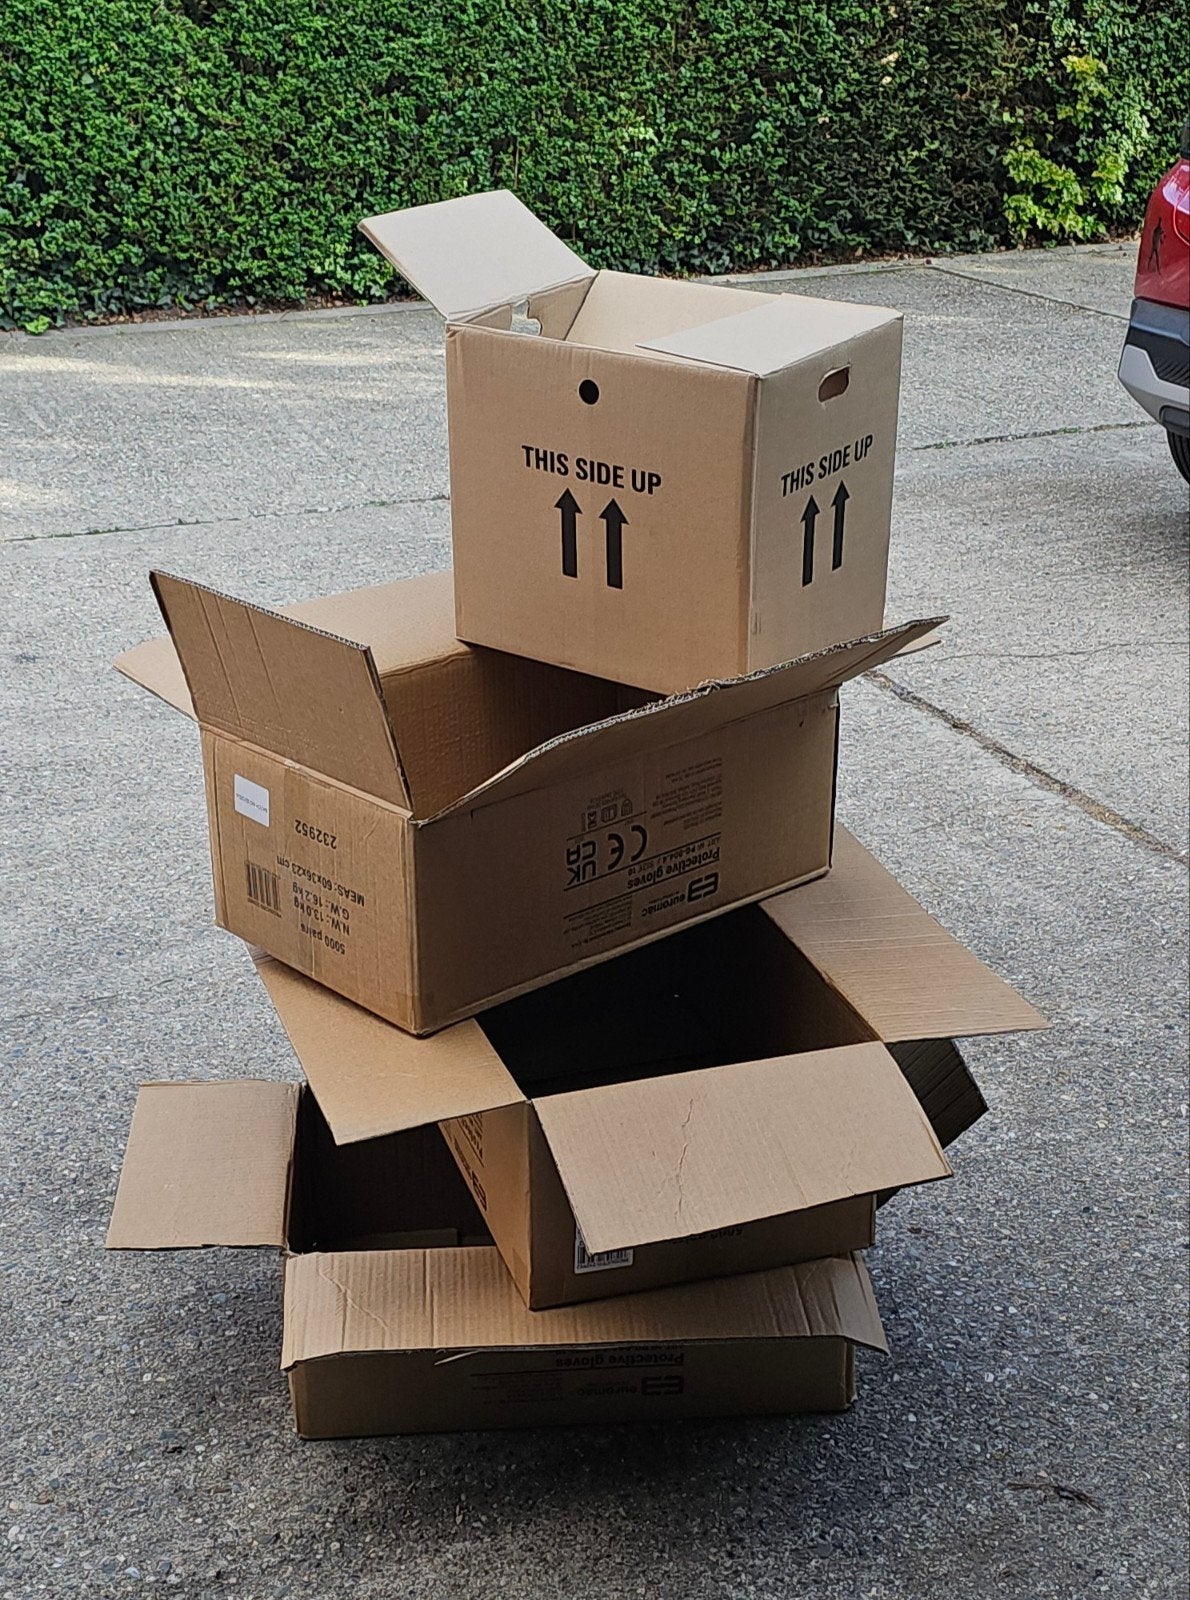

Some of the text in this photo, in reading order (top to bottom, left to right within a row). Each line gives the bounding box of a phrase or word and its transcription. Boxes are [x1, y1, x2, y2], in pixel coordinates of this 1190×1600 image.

[521, 445, 662, 495] THIS SIDE UP
[780, 433, 873, 497] THIS SIDE UP
[294, 819, 337, 850] 232952
[277, 855, 290, 869] cm
[566, 840, 597, 866] CA
[291, 862, 333, 891] 60x36x23
[566, 860, 597, 886] UK
[627, 847, 720, 889] Protective gloves
[292, 881, 304, 899] kg
[305, 889, 323, 906] 16.2
[334, 881, 365, 907] MEAS:
[293, 896, 305, 915] kg
[306, 907, 324, 923] 13.0
[642, 893, 685, 917] euromac
[300, 922, 346, 955] 5000 pairs
[555, 1353, 684, 1369] Protective gloves
